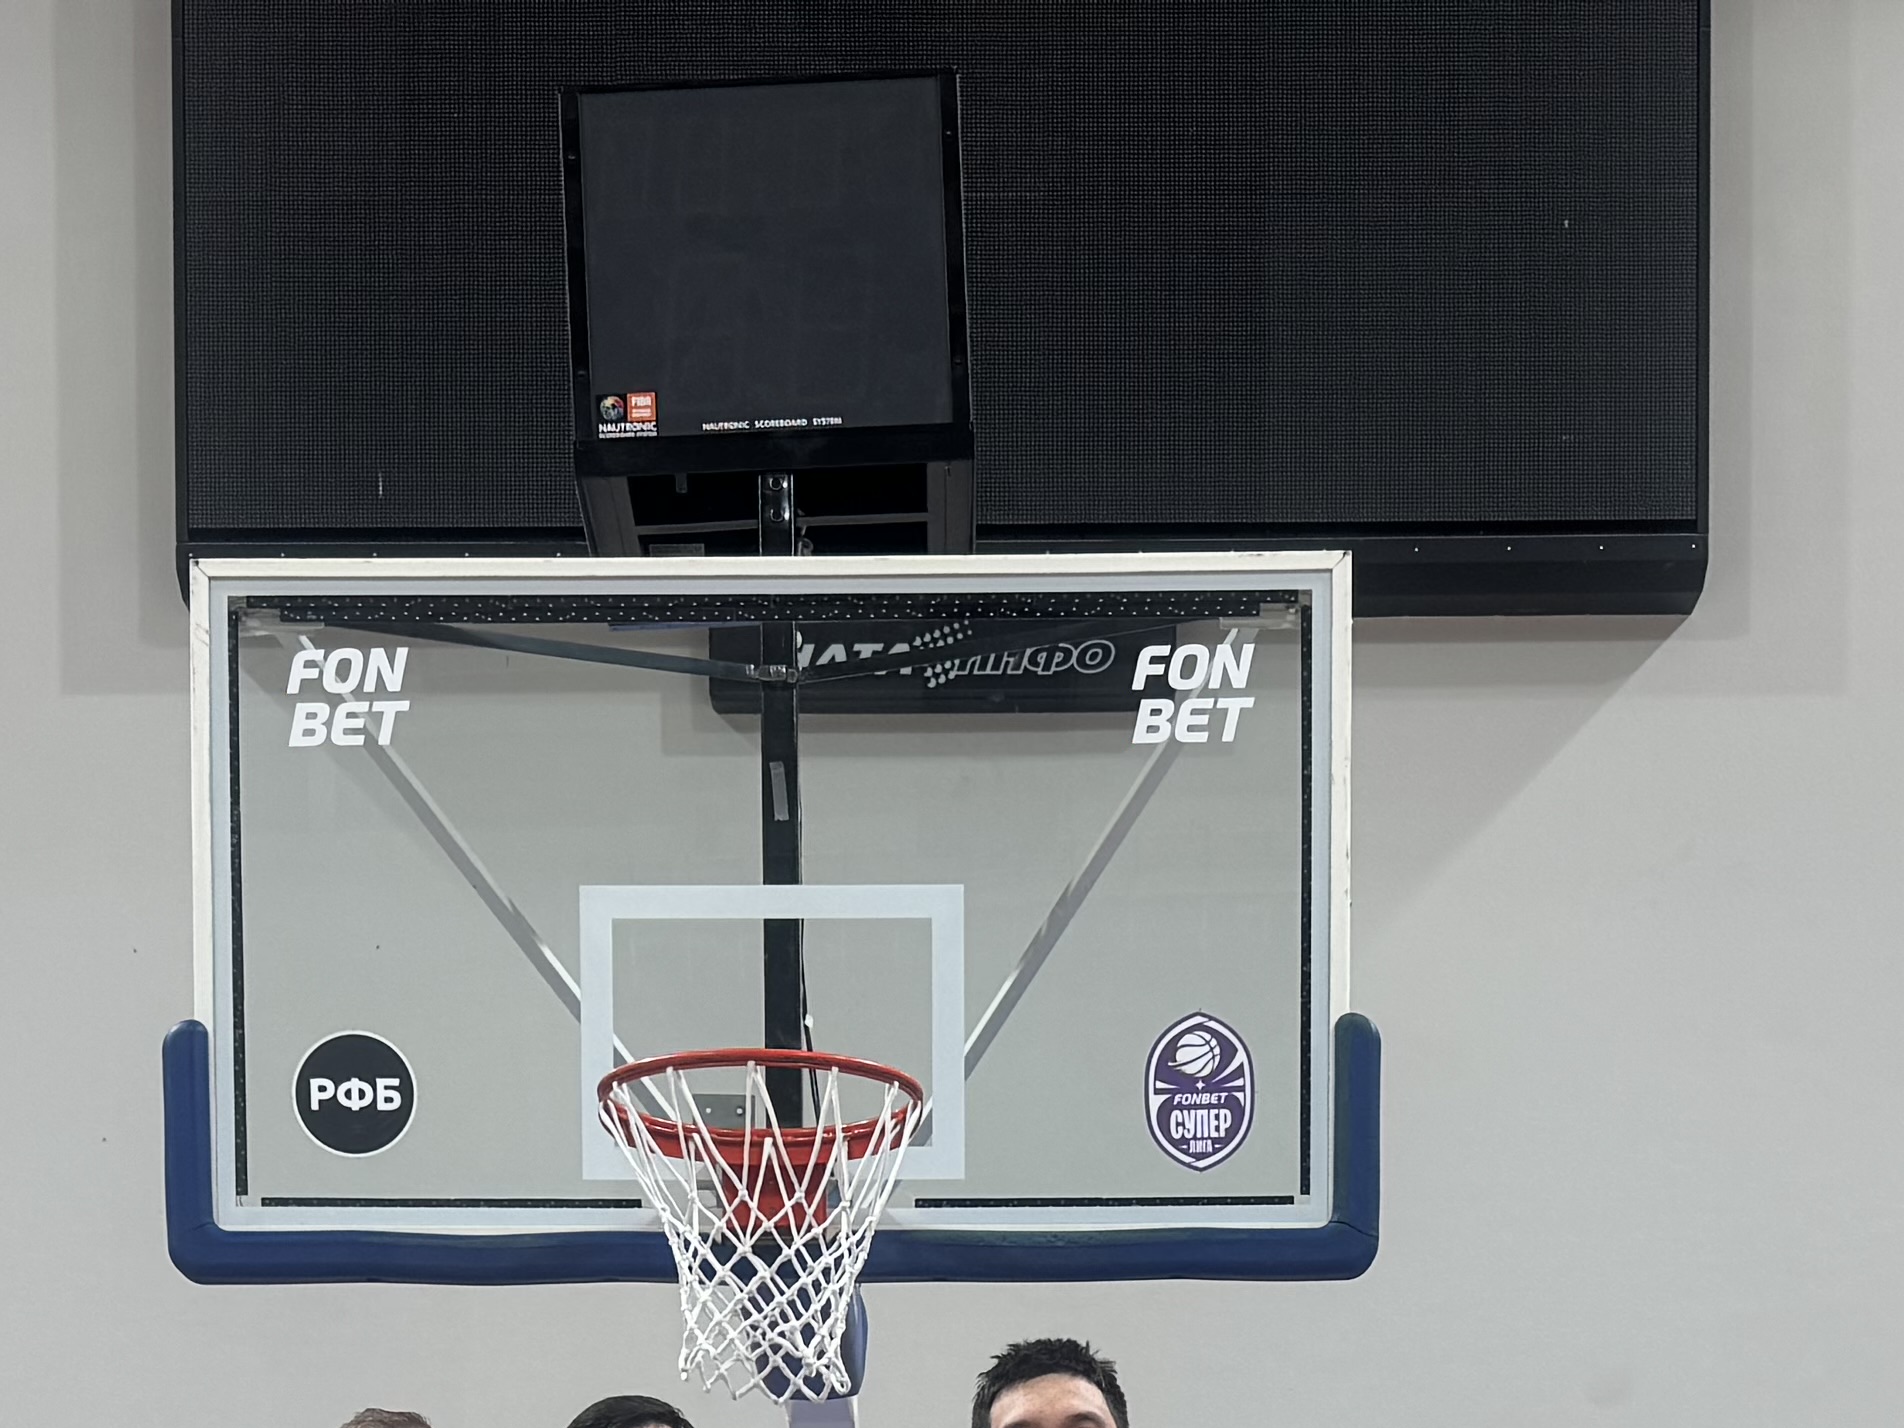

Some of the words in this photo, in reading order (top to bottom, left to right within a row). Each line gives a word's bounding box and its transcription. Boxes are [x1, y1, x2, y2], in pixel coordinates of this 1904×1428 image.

[286, 646, 409, 695] FON
[1131, 643, 1256, 691] FON
[288, 700, 411, 747] BET
[1131, 697, 1256, 744] BET
[309, 1077, 402, 1111] РФБ
[1173, 1092, 1229, 1105] FONBET
[1169, 1108, 1232, 1139] СУПЕР
[1189, 1139, 1213, 1153] ЛИГА
